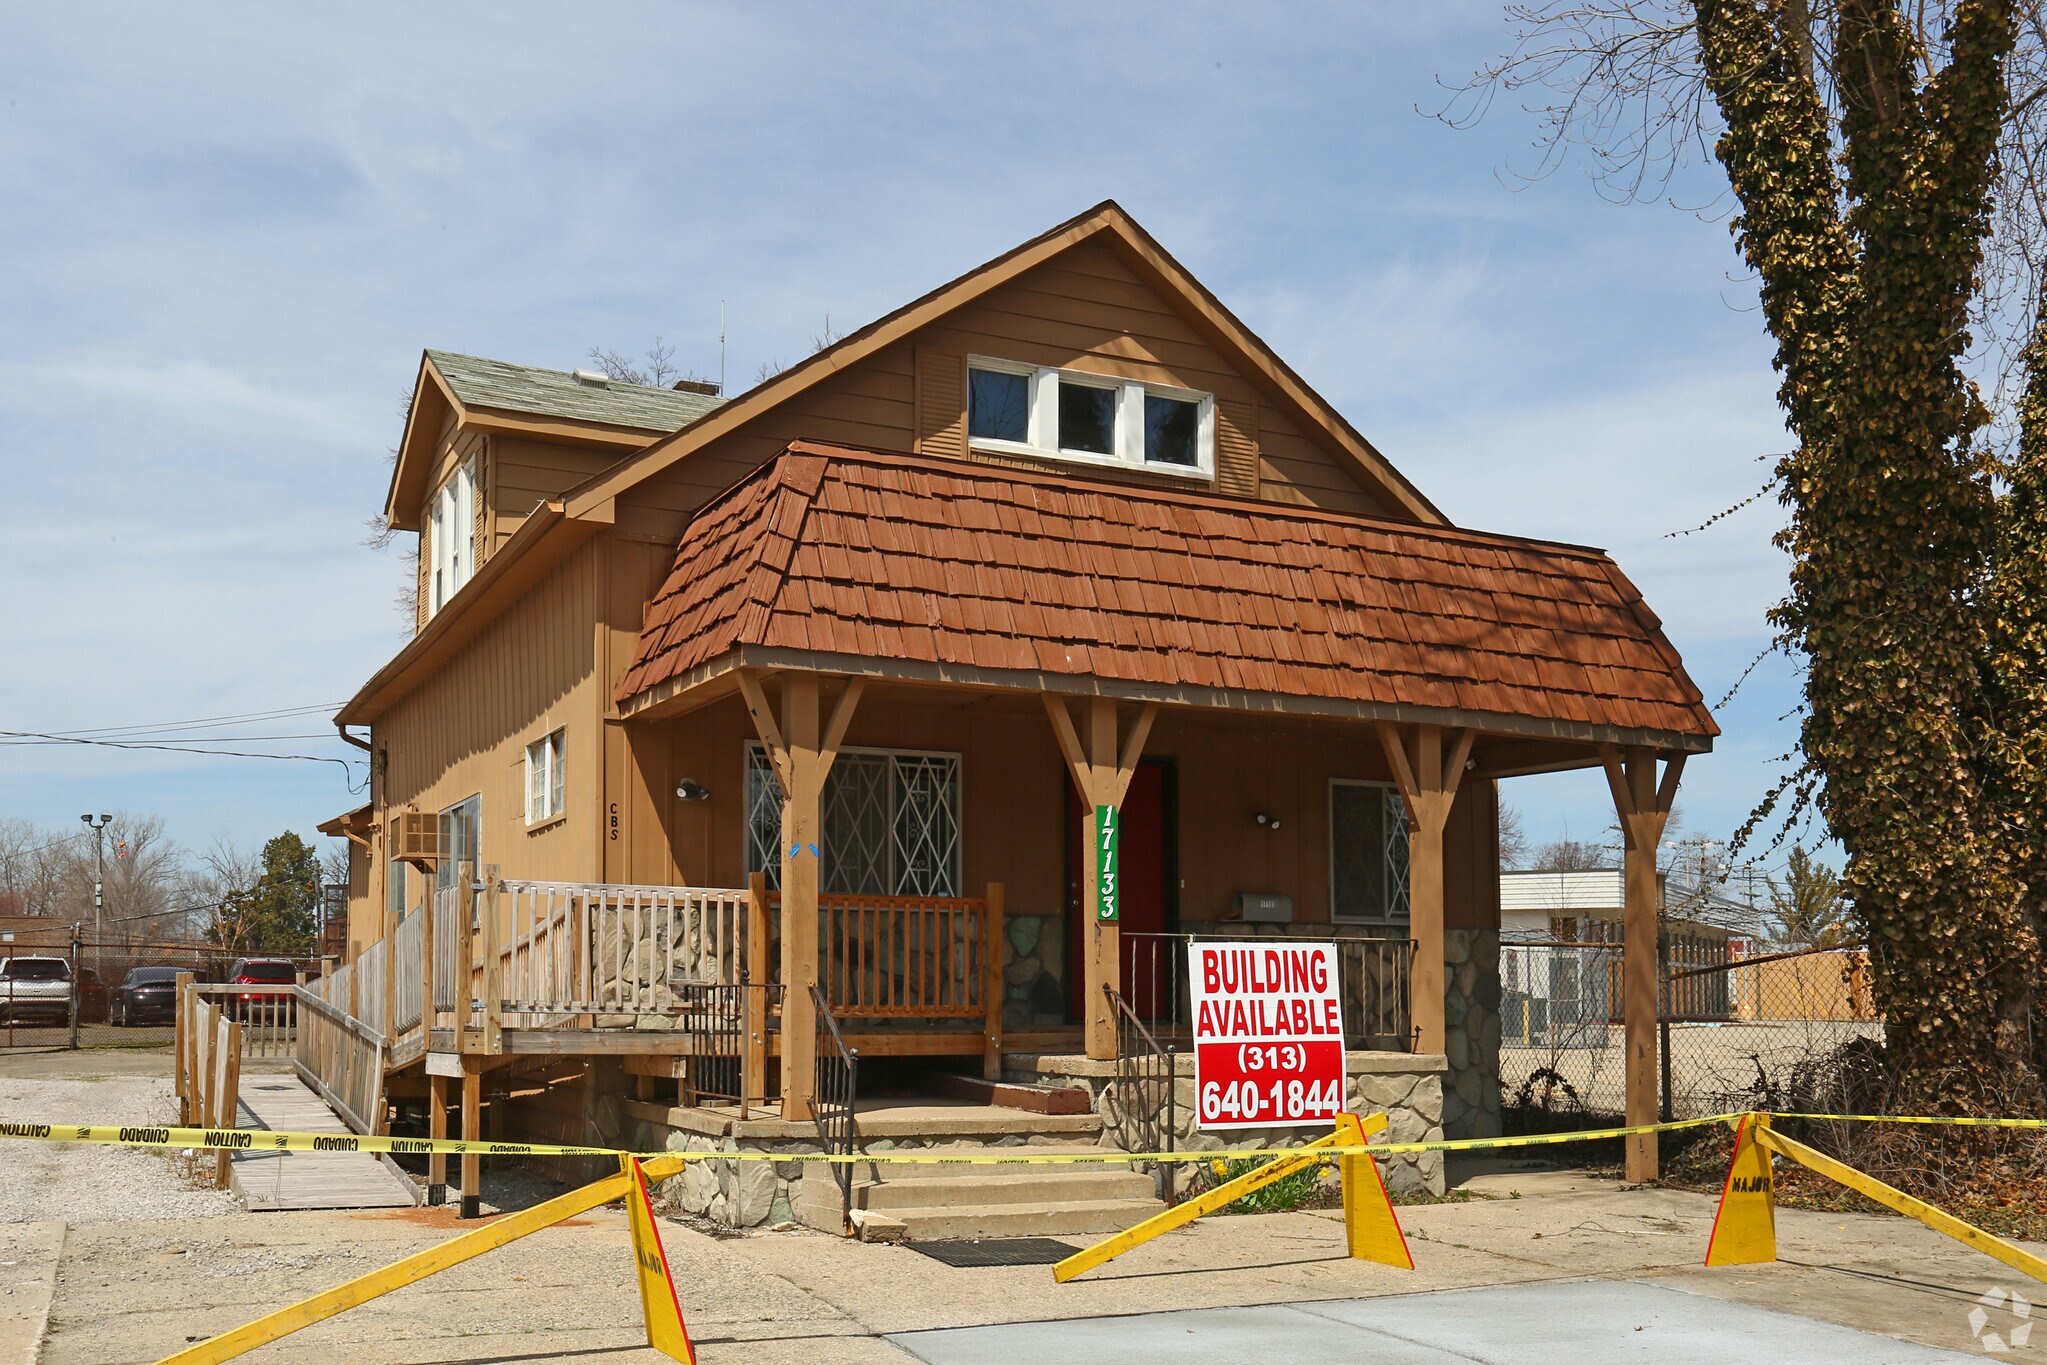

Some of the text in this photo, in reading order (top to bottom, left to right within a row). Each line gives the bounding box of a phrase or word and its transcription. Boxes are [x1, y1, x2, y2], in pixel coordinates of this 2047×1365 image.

[610, 802, 619, 840] CBS
[1101, 805, 1115, 918] 17133
[1202, 949, 1328, 995] BUILDING
[1197, 999, 1340, 1037] AVAILABLE
[1237, 1043, 1307, 1073] (313)
[1202, 1079, 1340, 1120] 640-1844
[0, 1123, 51, 1138] CAUTION
[119, 1127, 170, 1144] CUIDADO
[204, 1131, 252, 1148] CAUTION
[313, 1136, 358, 1152] CUIDADO
[391, 1140, 433, 1153] CAUTION
[1732, 1176, 1771, 1193] MAJOR
